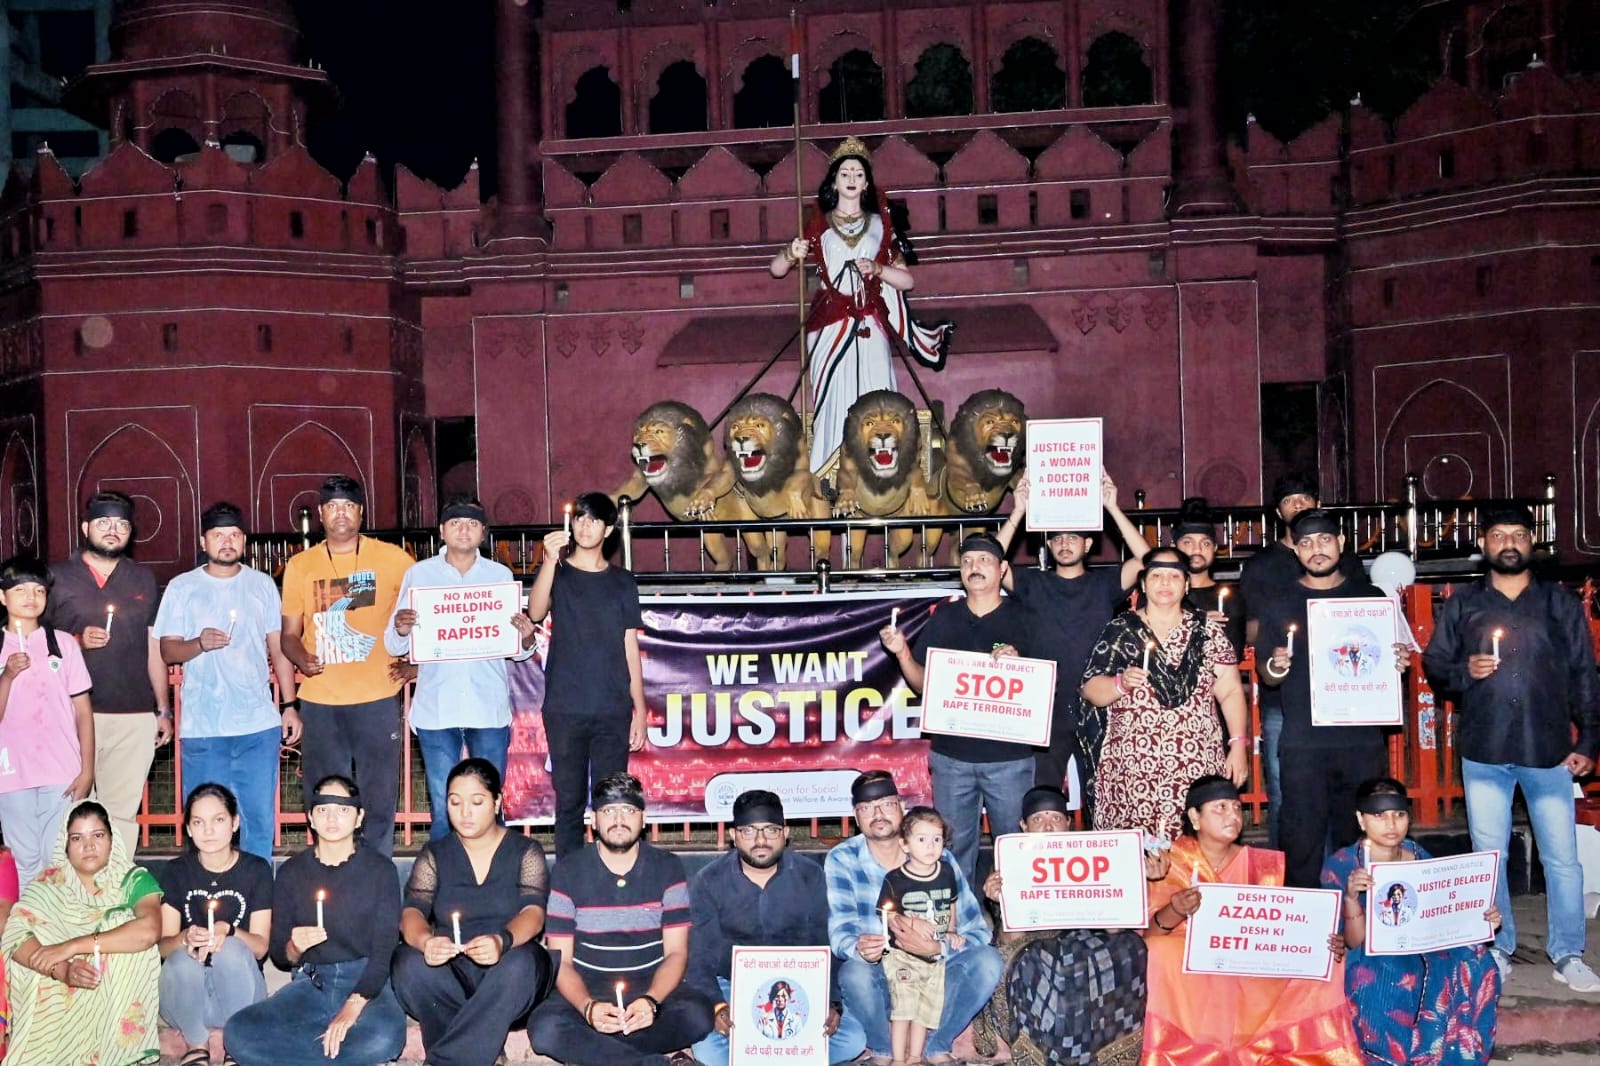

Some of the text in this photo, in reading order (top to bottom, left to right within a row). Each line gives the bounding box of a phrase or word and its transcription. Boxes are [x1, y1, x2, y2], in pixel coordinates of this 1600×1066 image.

[1032, 442, 1096, 453] JUSTICE FOR
[1049, 457, 1091, 467] WOMAN
[1039, 473, 1090, 483] A DOCTOR
[1041, 487, 1088, 497] A HUMAN
[444, 590, 493, 601] NO MORE
[433, 600, 503, 614] SHIELDING
[462, 615, 476, 624] OF
[437, 624, 500, 641] RAPISTS
[706, 651, 869, 686] WE WANT
[989, 661, 1003, 670] NOT
[1006, 663, 1035, 673] OBJECT
[955, 672, 1024, 700] STOP
[943, 700, 1032, 718] RAPE TERRORISM
[647, 687, 921, 748] JUSTICE
[1047, 841, 1063, 849] ARE
[1066, 840, 1083, 849] NOT
[1086, 839, 1119, 848] OBJECT
[1032, 856, 1110, 883] STOP
[1417, 873, 1491, 893] JUSTICE DELAYED
[1020, 889, 1123, 900] RAPE TERRORISM
[1237, 892, 1294, 904] DESH TOH
[1449, 891, 1457, 900] IS
[1218, 905, 1309, 924] AZAAD HAI,
[1420, 899, 1485, 919] JUSTICE DENIED
[1240, 925, 1284, 936] DESH KI
[1209, 935, 1312, 954] BETI KAB HOGI
